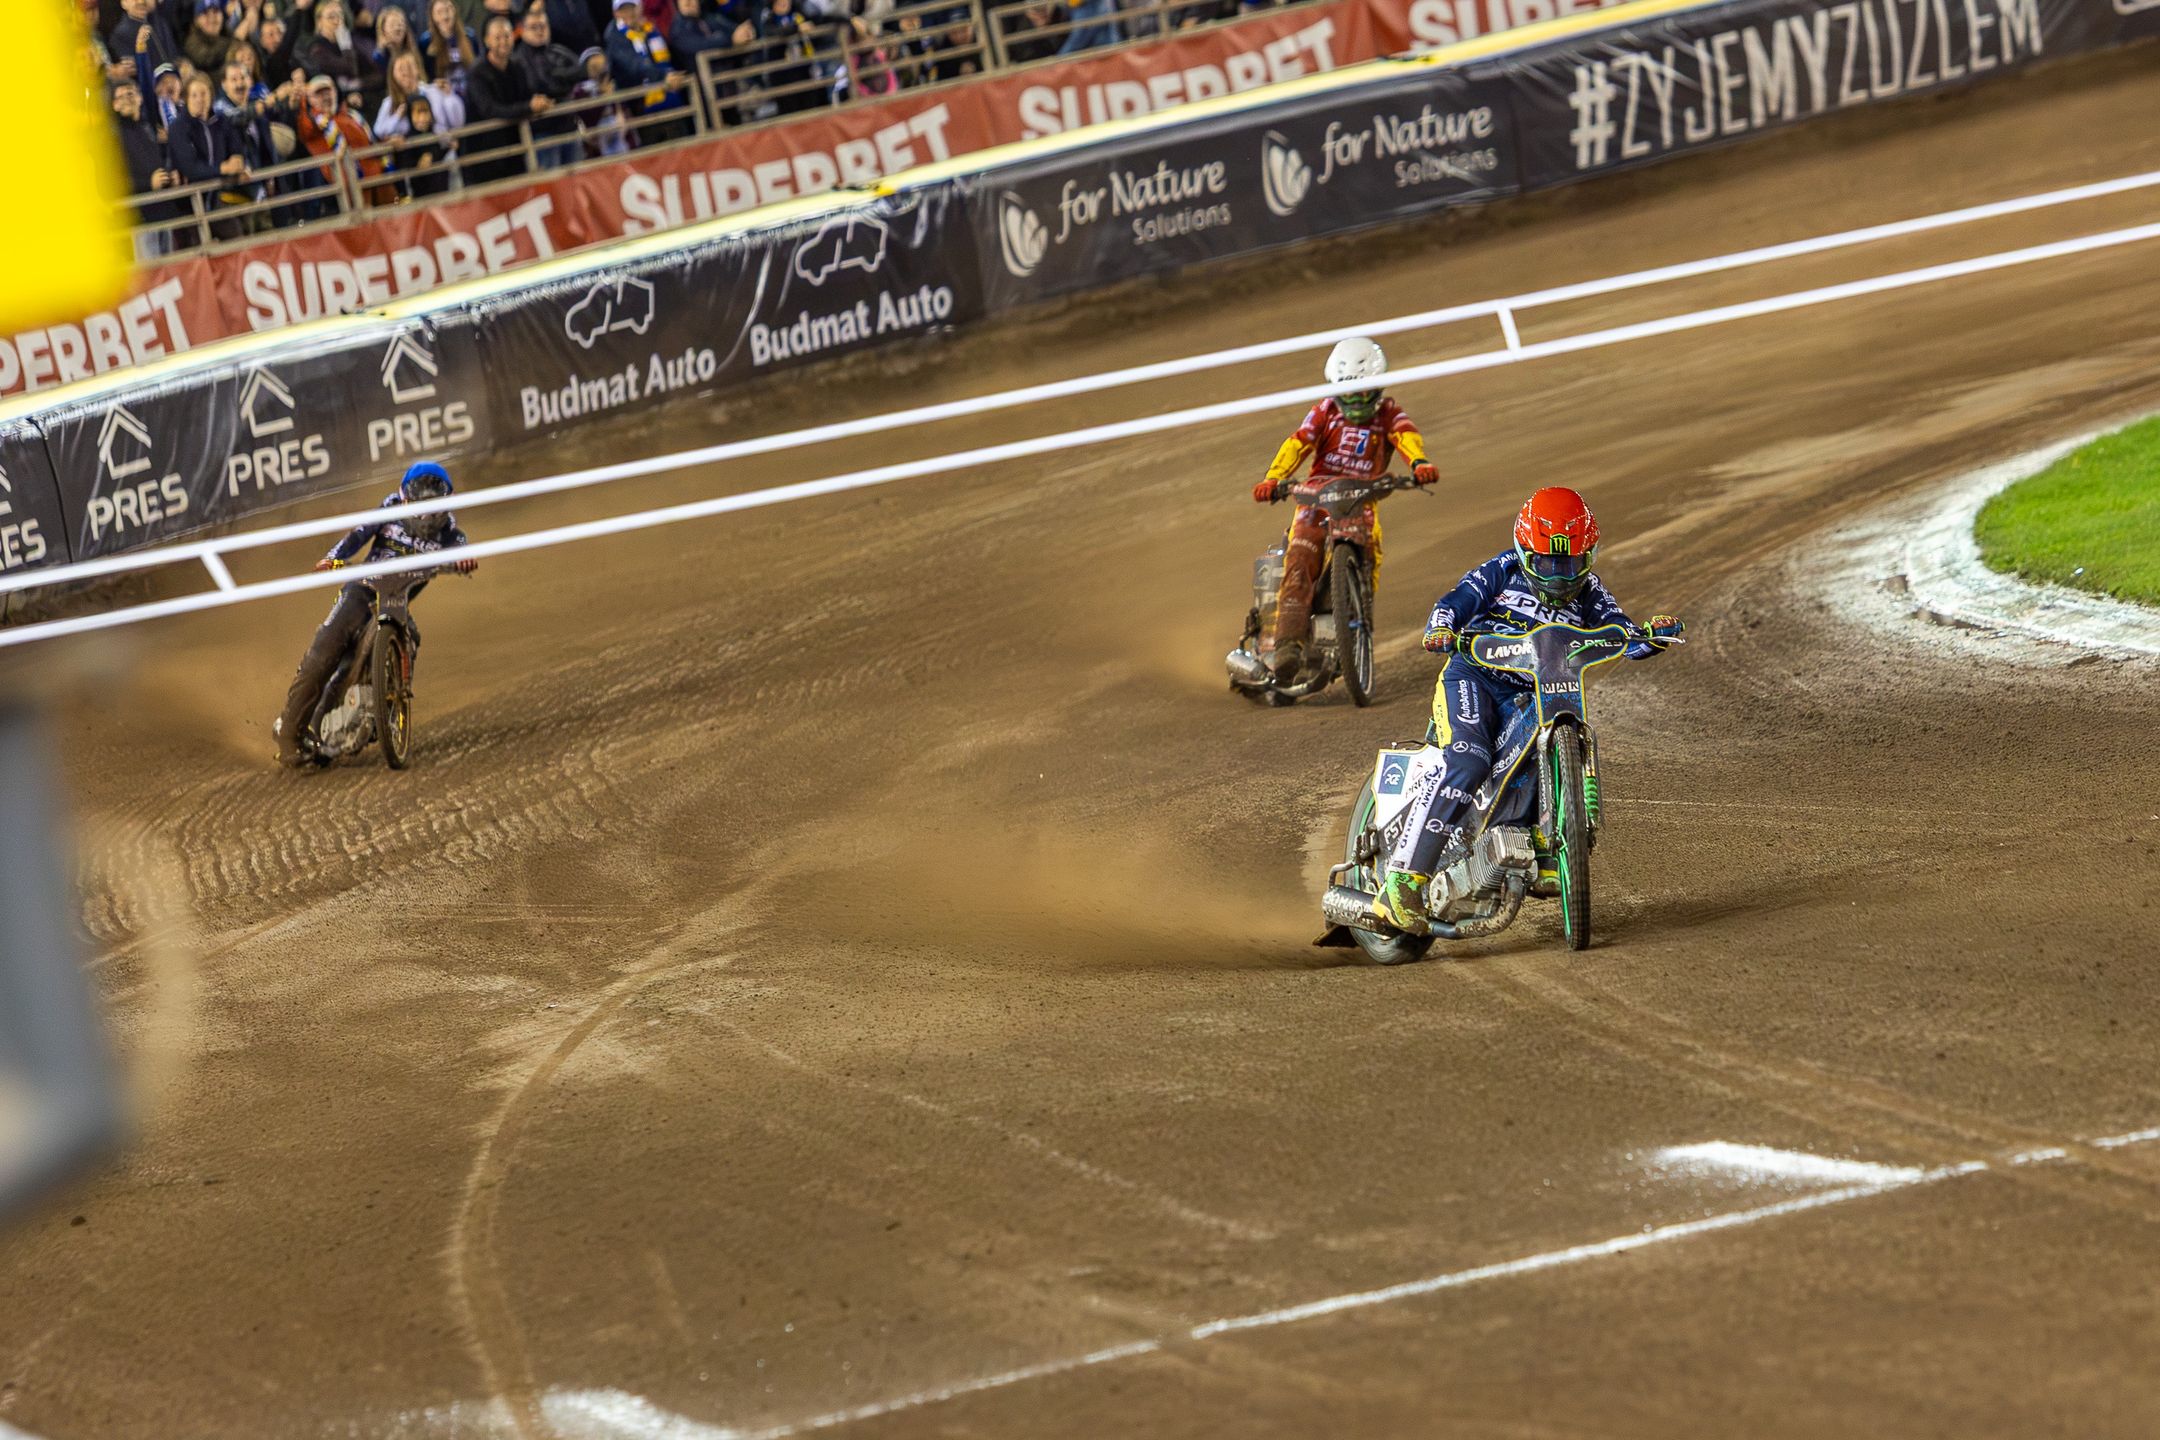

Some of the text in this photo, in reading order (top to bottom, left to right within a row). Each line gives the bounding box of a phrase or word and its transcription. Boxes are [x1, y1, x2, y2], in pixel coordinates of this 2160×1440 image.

[1319, 104, 1494, 184] for Nature
[1055, 160, 1227, 243] for Nature
[1133, 202, 1232, 246] Solutions
[243, 194, 554, 332] SUPERBET
[750, 284, 954, 367] Budmat Auto
[520, 348, 718, 430] Budmat Auto
[228, 434, 331, 498] PRES
[367, 401, 475, 462] PRES
[0, 517, 47, 571] ES
[88, 473, 189, 541] PRES
